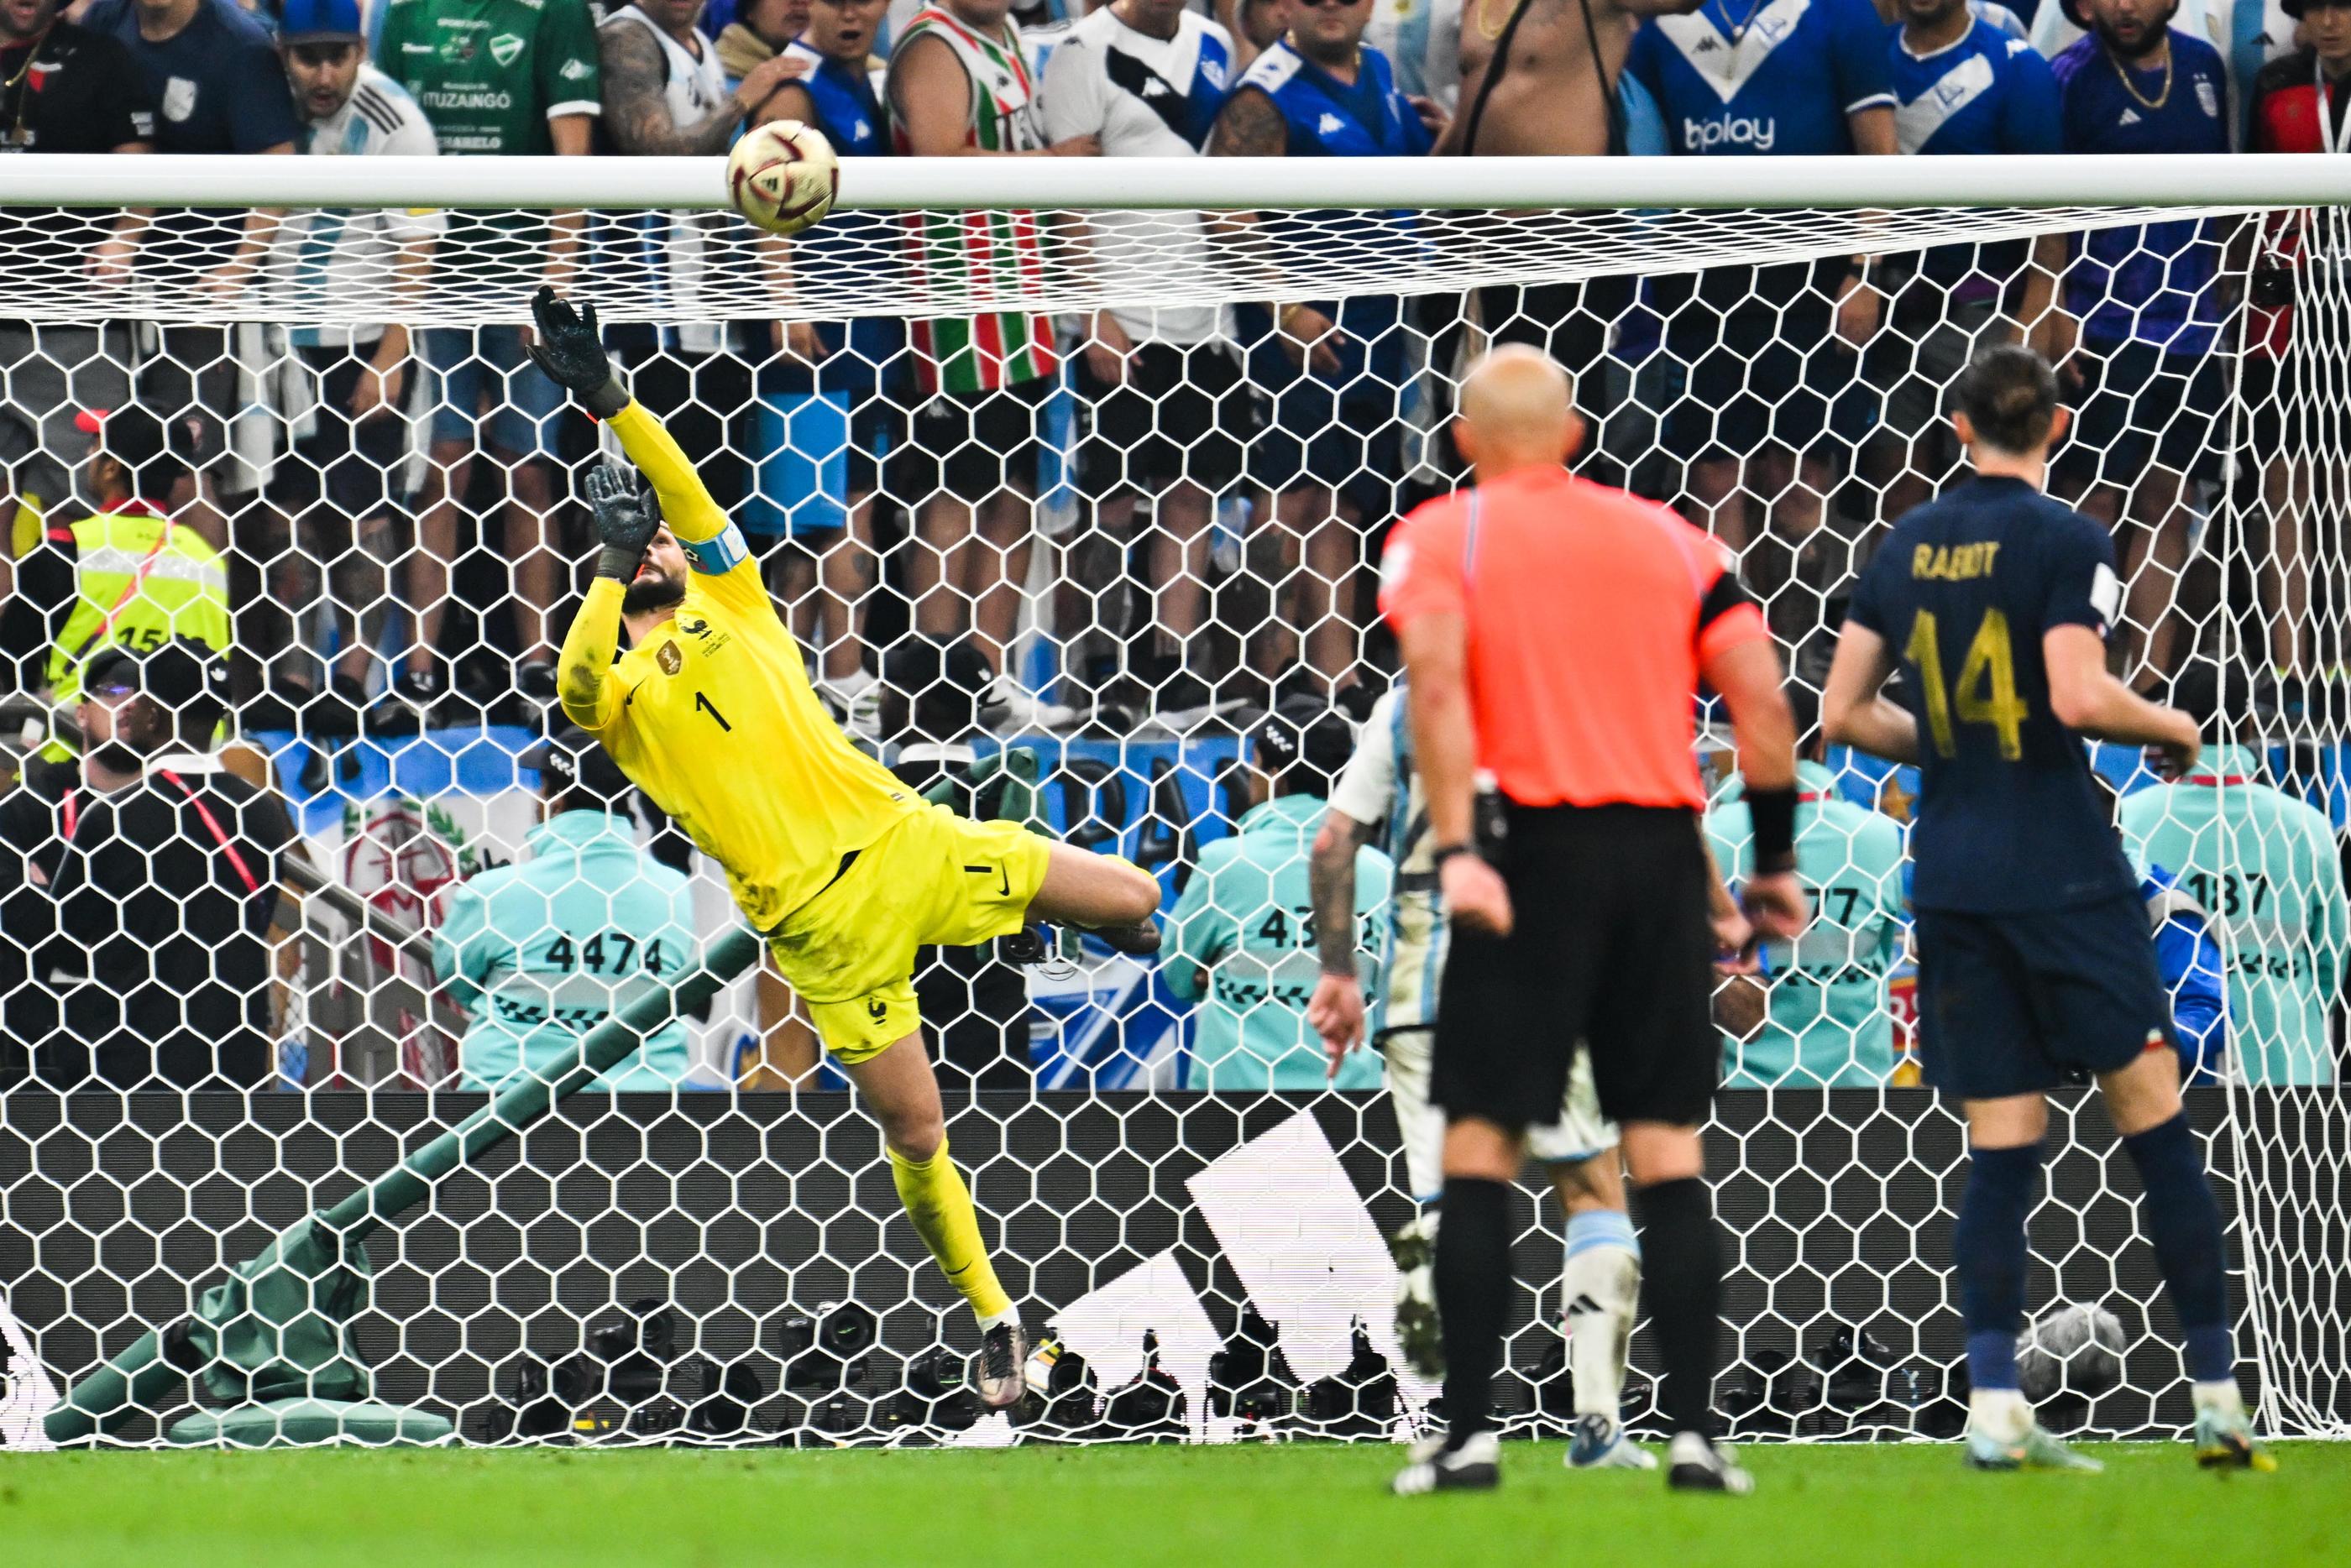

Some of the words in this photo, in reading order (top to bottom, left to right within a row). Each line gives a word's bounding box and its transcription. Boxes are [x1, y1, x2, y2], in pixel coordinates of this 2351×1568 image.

[1683, 112, 1775, 152] bplay
[1903, 606, 2029, 761] 14
[695, 691, 732, 733] 1
[2188, 873, 2266, 916] 187
[1259, 905, 1374, 952] 432
[545, 930, 662, 975] 4474
